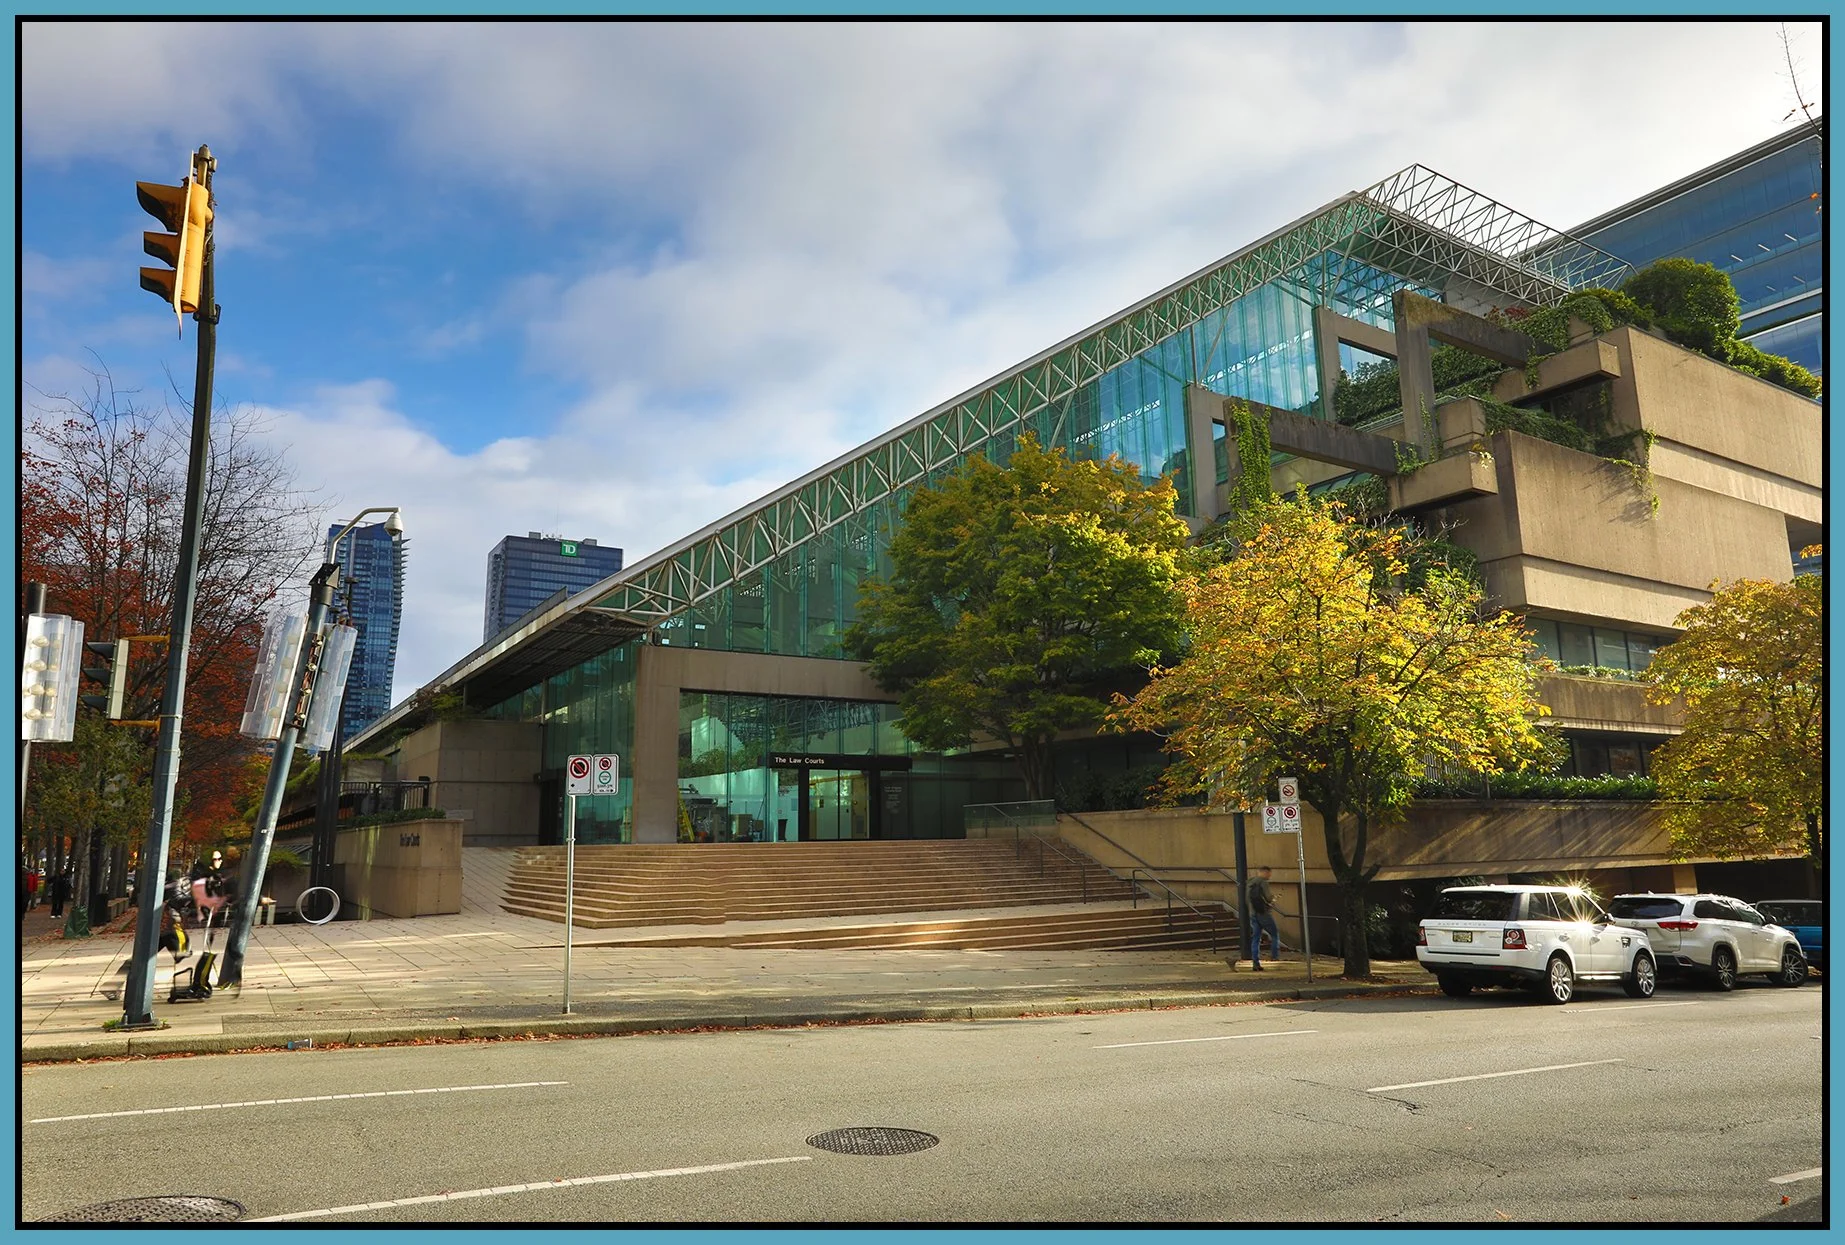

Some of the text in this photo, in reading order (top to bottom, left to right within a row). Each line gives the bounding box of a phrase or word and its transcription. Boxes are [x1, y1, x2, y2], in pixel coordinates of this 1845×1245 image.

[563, 543, 576, 554] TD
[775, 756, 787, 764] The
[804, 757, 825, 765] Courts
